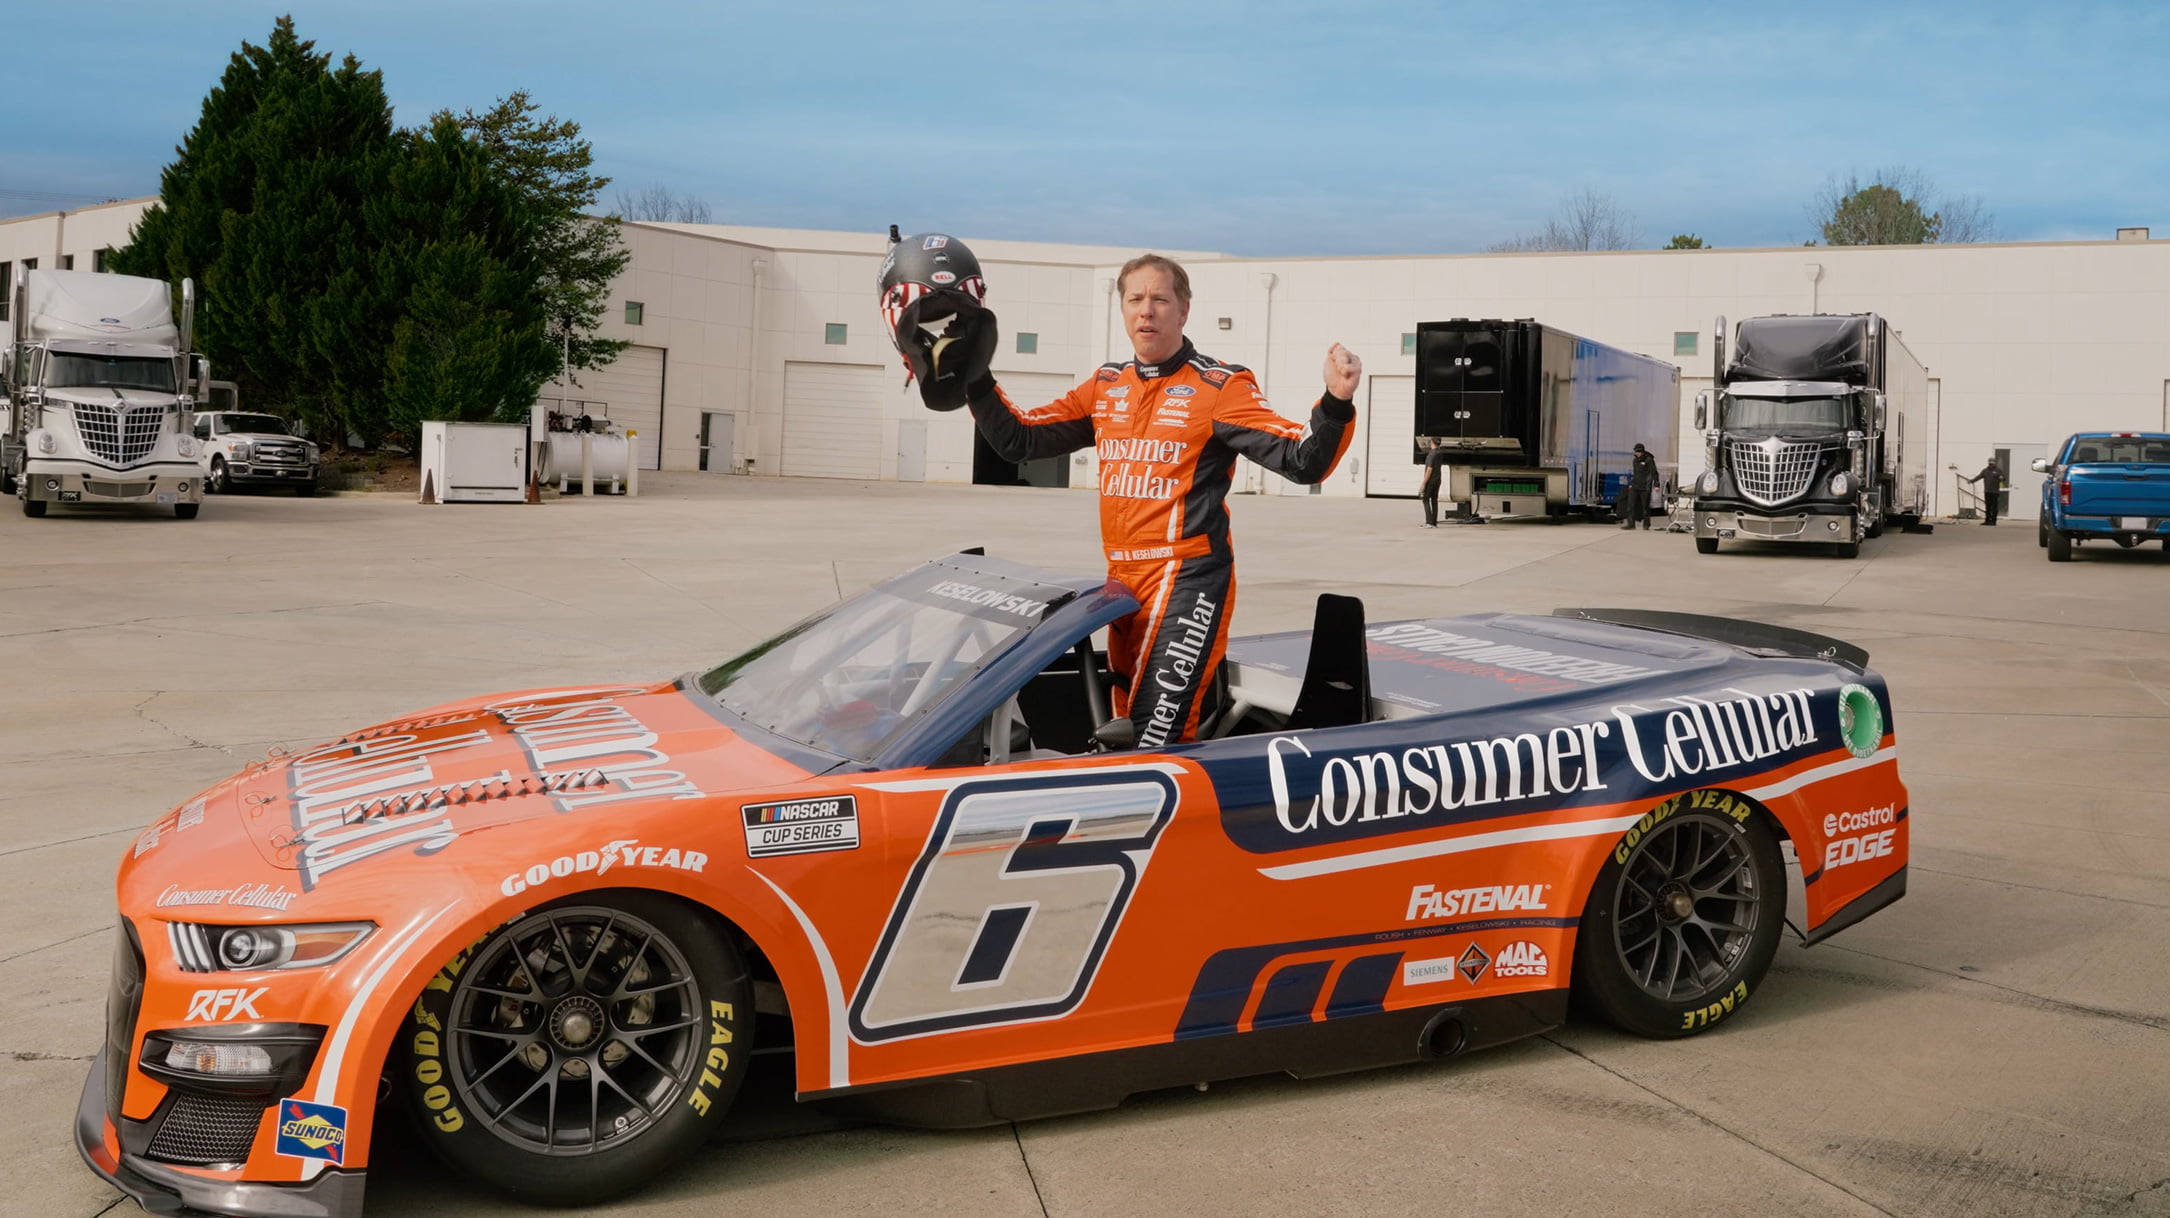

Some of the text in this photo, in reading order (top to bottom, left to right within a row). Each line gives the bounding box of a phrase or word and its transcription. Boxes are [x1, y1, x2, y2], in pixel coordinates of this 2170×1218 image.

[1095, 427, 1188, 464] Consumer
[1100, 463, 1180, 500] Cellular
[1132, 546, 1174, 561] KESELOWSKI
[926, 580, 1050, 618] KESELOWSKI
[1154, 592, 1217, 692] Cellular
[484, 688, 707, 811] Csumer
[1266, 686, 1818, 833] Consumer Cellular
[780, 801, 839, 821] NASCAR
[1838, 802, 1895, 832] Castrol
[763, 824, 843, 844] CUP SERIES
[1824, 828, 1896, 871] EDGE
[156, 883, 297, 911] Consumer Cellular
[849, 770, 1181, 1046] 6
[1410, 963, 1449, 978] SIEMENS
[1495, 941, 1547, 967] MAC
[1495, 966, 1548, 978] TOOLS
[184, 986, 270, 1022] RFK
[1681, 979, 1749, 1031] EAGLE
[688, 1000, 734, 1117] EAGLE
[285, 1122, 344, 1143] SUNOCO
